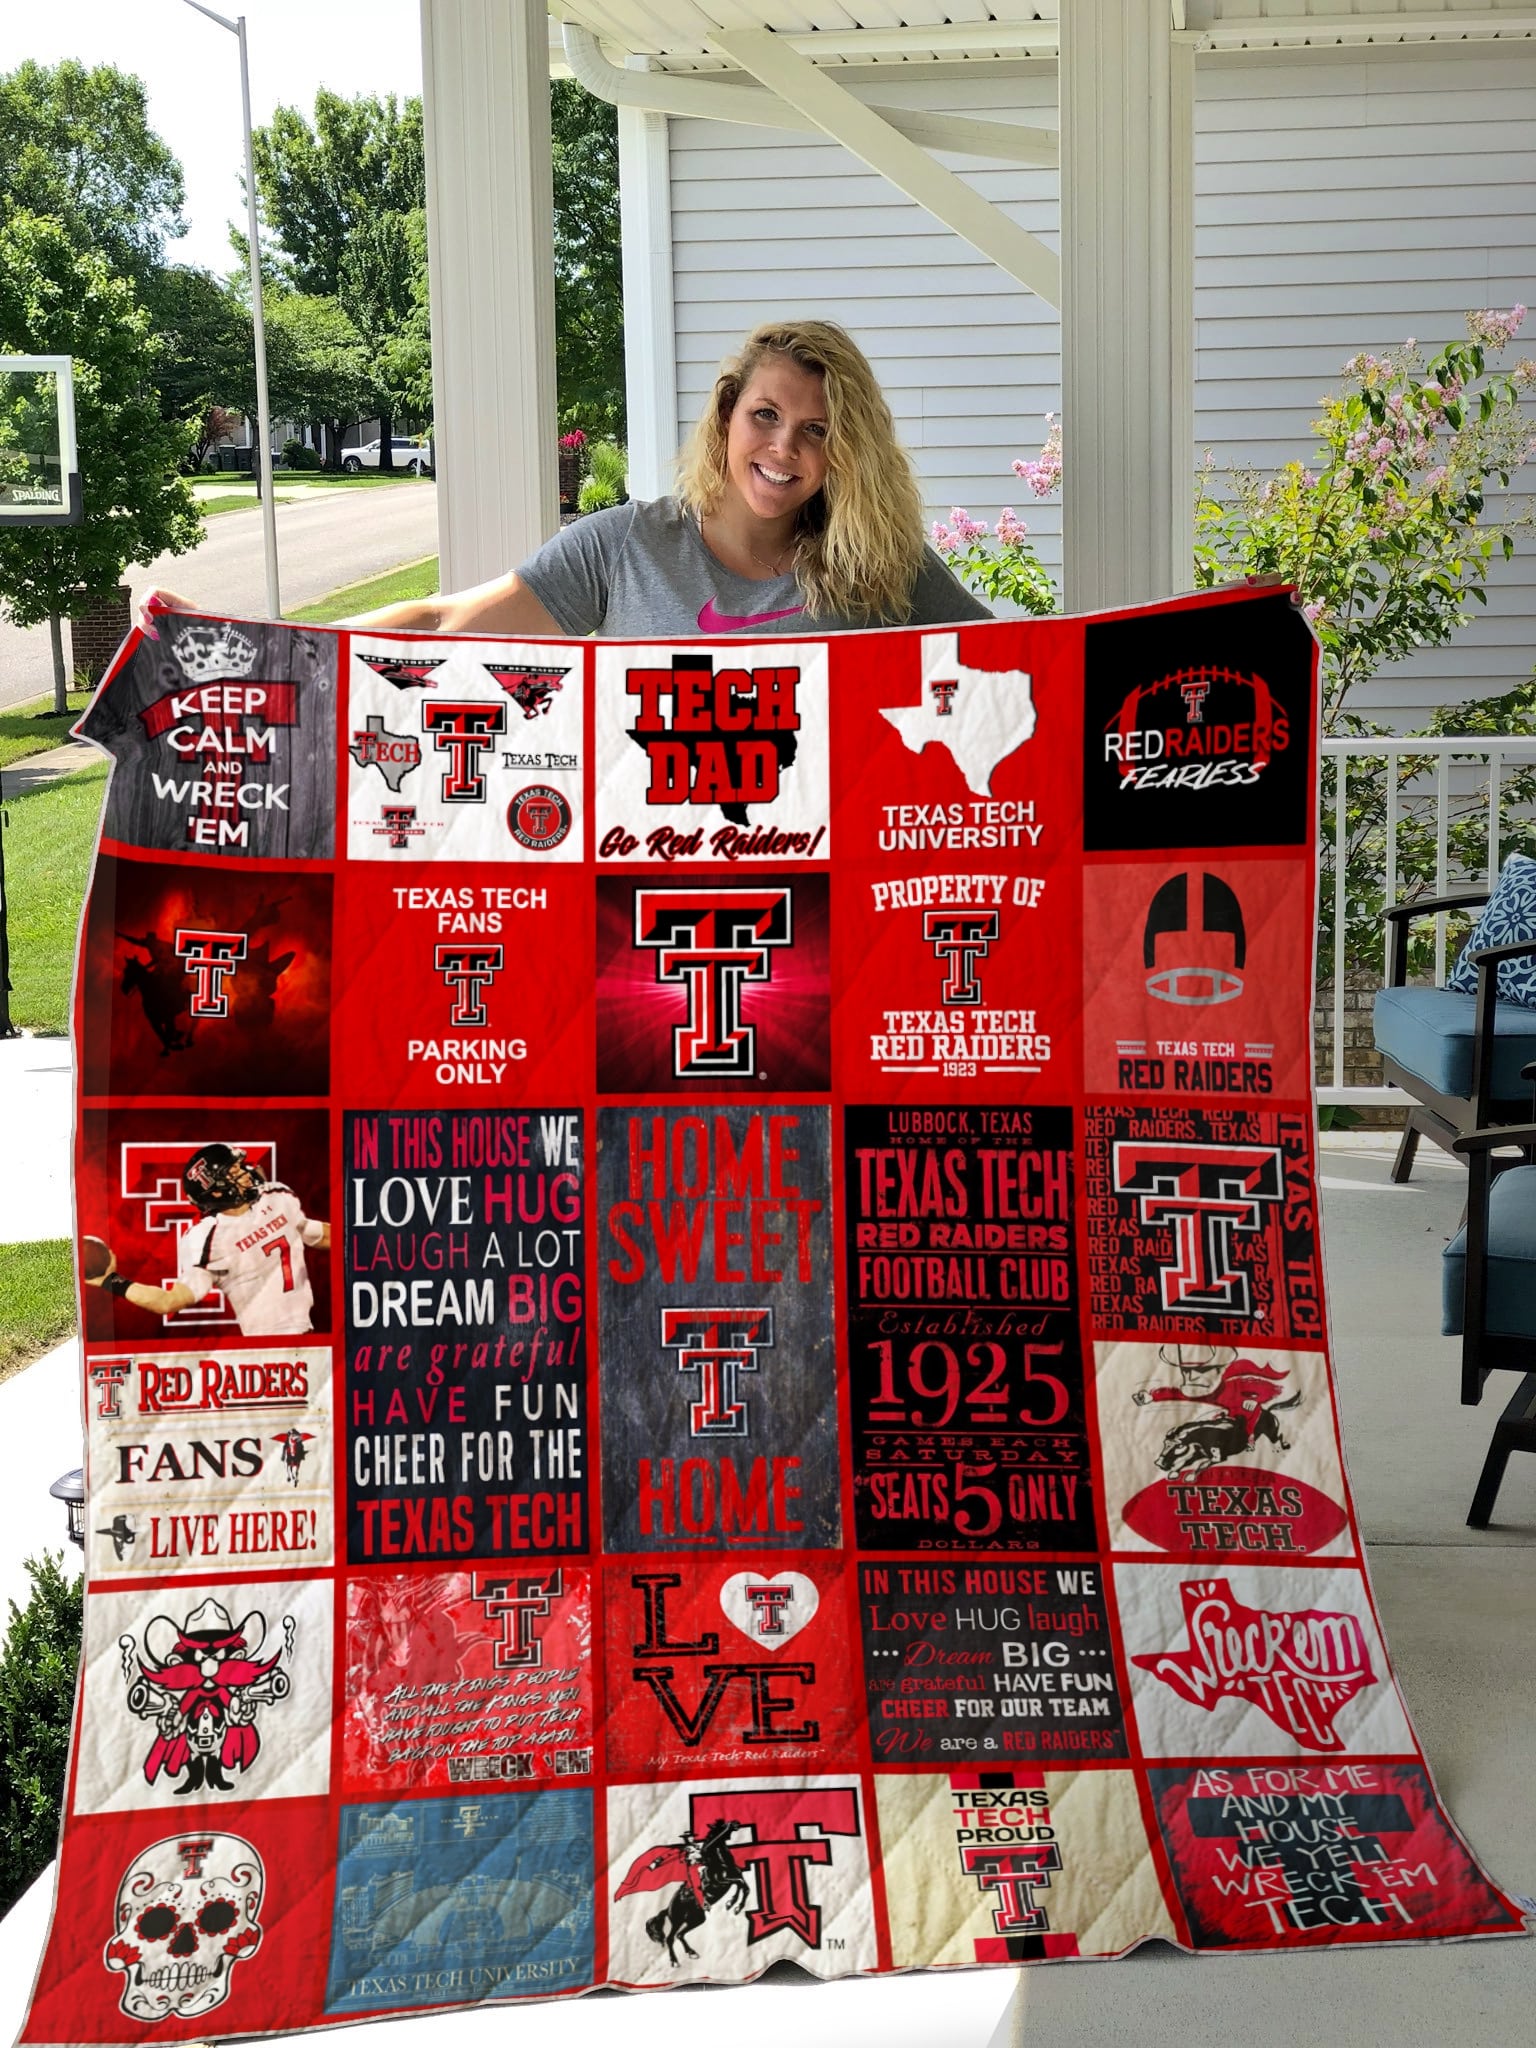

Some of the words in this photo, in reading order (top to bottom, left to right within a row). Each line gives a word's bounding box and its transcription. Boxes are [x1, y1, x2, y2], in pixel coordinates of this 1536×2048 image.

[13, 489, 61, 502] SPALDING
[171, 686, 267, 719] KEEP
[626, 667, 800, 732] TECH
[167, 726, 276, 753] CALM
[203, 761, 243, 774] AND
[502, 753, 541, 768] TEXAS
[545, 753, 577, 768] TECH
[646, 740, 779, 805] DAD
[1119, 760, 1267, 790] FEARLESS
[152, 772, 290, 810] WRECK
[515, 788, 540, 805] TEXAS
[544, 790, 564, 806] TECH
[882, 803, 963, 827] TEXAS
[969, 800, 1035, 824] TECH
[188, 816, 248, 847] 'EM
[514, 829, 530, 844] RED
[599, 825, 639, 858] Go
[646, 825, 704, 862] Red
[710, 825, 826, 862] Raiders!
[879, 824, 1043, 851] UNIVERSITY
[393, 888, 474, 909] TEXAS
[481, 888, 547, 908] TECH
[871, 875, 1008, 912] PROPERTY
[1013, 877, 1045, 908] OF
[438, 913, 502, 933] FANS
[883, 1010, 965, 1034] TEXAS
[971, 1010, 1036, 1034] TECH
[407, 1040, 528, 1061] PARKING
[870, 1035, 924, 1061] RED
[932, 1035, 1051, 1061] RAIDERS
[1157, 1041, 1198, 1056] TEXAS
[1202, 1042, 1235, 1057] TECH
[435, 1063, 508, 1084] ONLY
[943, 1063, 977, 1077] 1923
[1118, 1059, 1164, 1089] RED
[1174, 1060, 1273, 1093] RAIDERS
[889, 1111, 975, 1134] LUBBOCK,
[981, 1112, 1033, 1134] TEXAS
[1086, 1119, 1115, 1137] RED
[1129, 1119, 1195, 1138] RAIDERS
[1210, 1122, 1260, 1141] TEXAS
[353, 1118, 378, 1169] IN
[388, 1117, 443, 1169] THIS
[452, 1117, 530, 1168] HOUSE
[540, 1116, 579, 1166] WE
[628, 1115, 799, 1200] HOME
[856, 1148, 969, 1218] TEXAS
[977, 1150, 1069, 1221] TECH
[1280, 1114, 1313, 1232] TEXAS
[352, 1176, 474, 1227] LOVE
[485, 1173, 581, 1224] HUG
[235, 1228, 268, 1253] TEXAS
[353, 1232, 469, 1271] LAUGH
[482, 1232, 504, 1268] A
[518, 1230, 581, 1267] LOT
[607, 1201, 822, 1285] SWEET
[857, 1223, 921, 1248] RED
[929, 1223, 1069, 1250] RAIDERS
[261, 1235, 294, 1293] 7
[859, 1256, 991, 1300] FOOTBALL
[1000, 1258, 1069, 1301] CLUB
[352, 1279, 494, 1328] DREAM
[508, 1272, 582, 1324] BIG
[1287, 1255, 1322, 1339] TECH
[878, 1310, 1052, 1336] Established
[355, 1344, 411, 1373] are
[426, 1327, 580, 1386] grateful
[138, 1363, 192, 1412] RED
[198, 1360, 308, 1408] RAIDERS
[868, 1340, 1069, 1428] 1925
[353, 1386, 466, 1426] HAVE
[495, 1383, 578, 1421] FUN
[866, 1450, 1079, 1462] SATURDAY
[872, 1437, 974, 1446] GAMES
[991, 1438, 1071, 1447] EACH
[115, 1438, 263, 1484] FANS
[355, 1433, 445, 1487] CHEER
[461, 1431, 514, 1482] FOR
[529, 1429, 582, 1480] THE
[639, 1456, 805, 1534] HOME
[871, 1472, 948, 1520] SEATS
[954, 1463, 1002, 1536] 5
[1009, 1474, 1077, 1521] ONLY
[1168, 1485, 1304, 1517] TEXAS
[150, 1515, 220, 1558] LIVE
[228, 1509, 317, 1554] HERE!
[357, 1496, 475, 1556] TEXAS
[486, 1492, 581, 1550] TECH
[918, 1540, 1040, 1549] DOLLARS
[864, 1570, 889, 1594] IN
[899, 1569, 956, 1594] THIS
[965, 1570, 1049, 1594] HOUSE
[1056, 1570, 1096, 1595] WE
[869, 1605, 947, 1631] Love
[955, 1608, 1021, 1631] HUG
[1028, 1603, 1099, 1637] laugh
[904, 1641, 995, 1667] Dream
[1002, 1641, 1070, 1667] BIG
[869, 1680, 895, 1691] are
[901, 1675, 987, 1694] grateful
[993, 1673, 1056, 1693] HAVE
[1061, 1673, 1114, 1692] FUN
[881, 1699, 950, 1719] CHEER
[955, 1699, 995, 1718] FOR
[1001, 1698, 1044, 1717] OUR
[1050, 1698, 1111, 1717] TEAM
[1248, 1671, 1335, 1744] TECH
[744, 1750, 767, 1760] Red
[876, 1728, 933, 1755] We
[940, 1736, 977, 1750] are
[983, 1738, 998, 1749] a
[1002, 1733, 1036, 1751] RED
[1041, 1729, 1113, 1750] RAIDERS
[449, 1752, 535, 1782] WRECK
[1192, 1769, 1234, 1798] AS
[1247, 1768, 1320, 1793] FOR
[1325, 1765, 1379, 1790] ME
[952, 1791, 1049, 1807] TEXAS
[1221, 1792, 1289, 1818] AND
[1299, 1791, 1348, 1816] MY
[953, 1807, 1051, 1827] TECH
[1235, 1817, 1365, 1844] HOUSE
[956, 1827, 1055, 1843] PROUD
[1216, 1845, 1286, 1872] WE
[1296, 1844, 1407, 1870] YELL
[1212, 1871, 1371, 1896] WRECK
[1245, 1893, 1414, 1934] TECH
[826, 1938, 845, 1950] TM
[349, 1976, 407, 1996] TEXAS
[414, 1971, 463, 1990] TECH
[470, 1957, 580, 1984] UNIVERSITY
